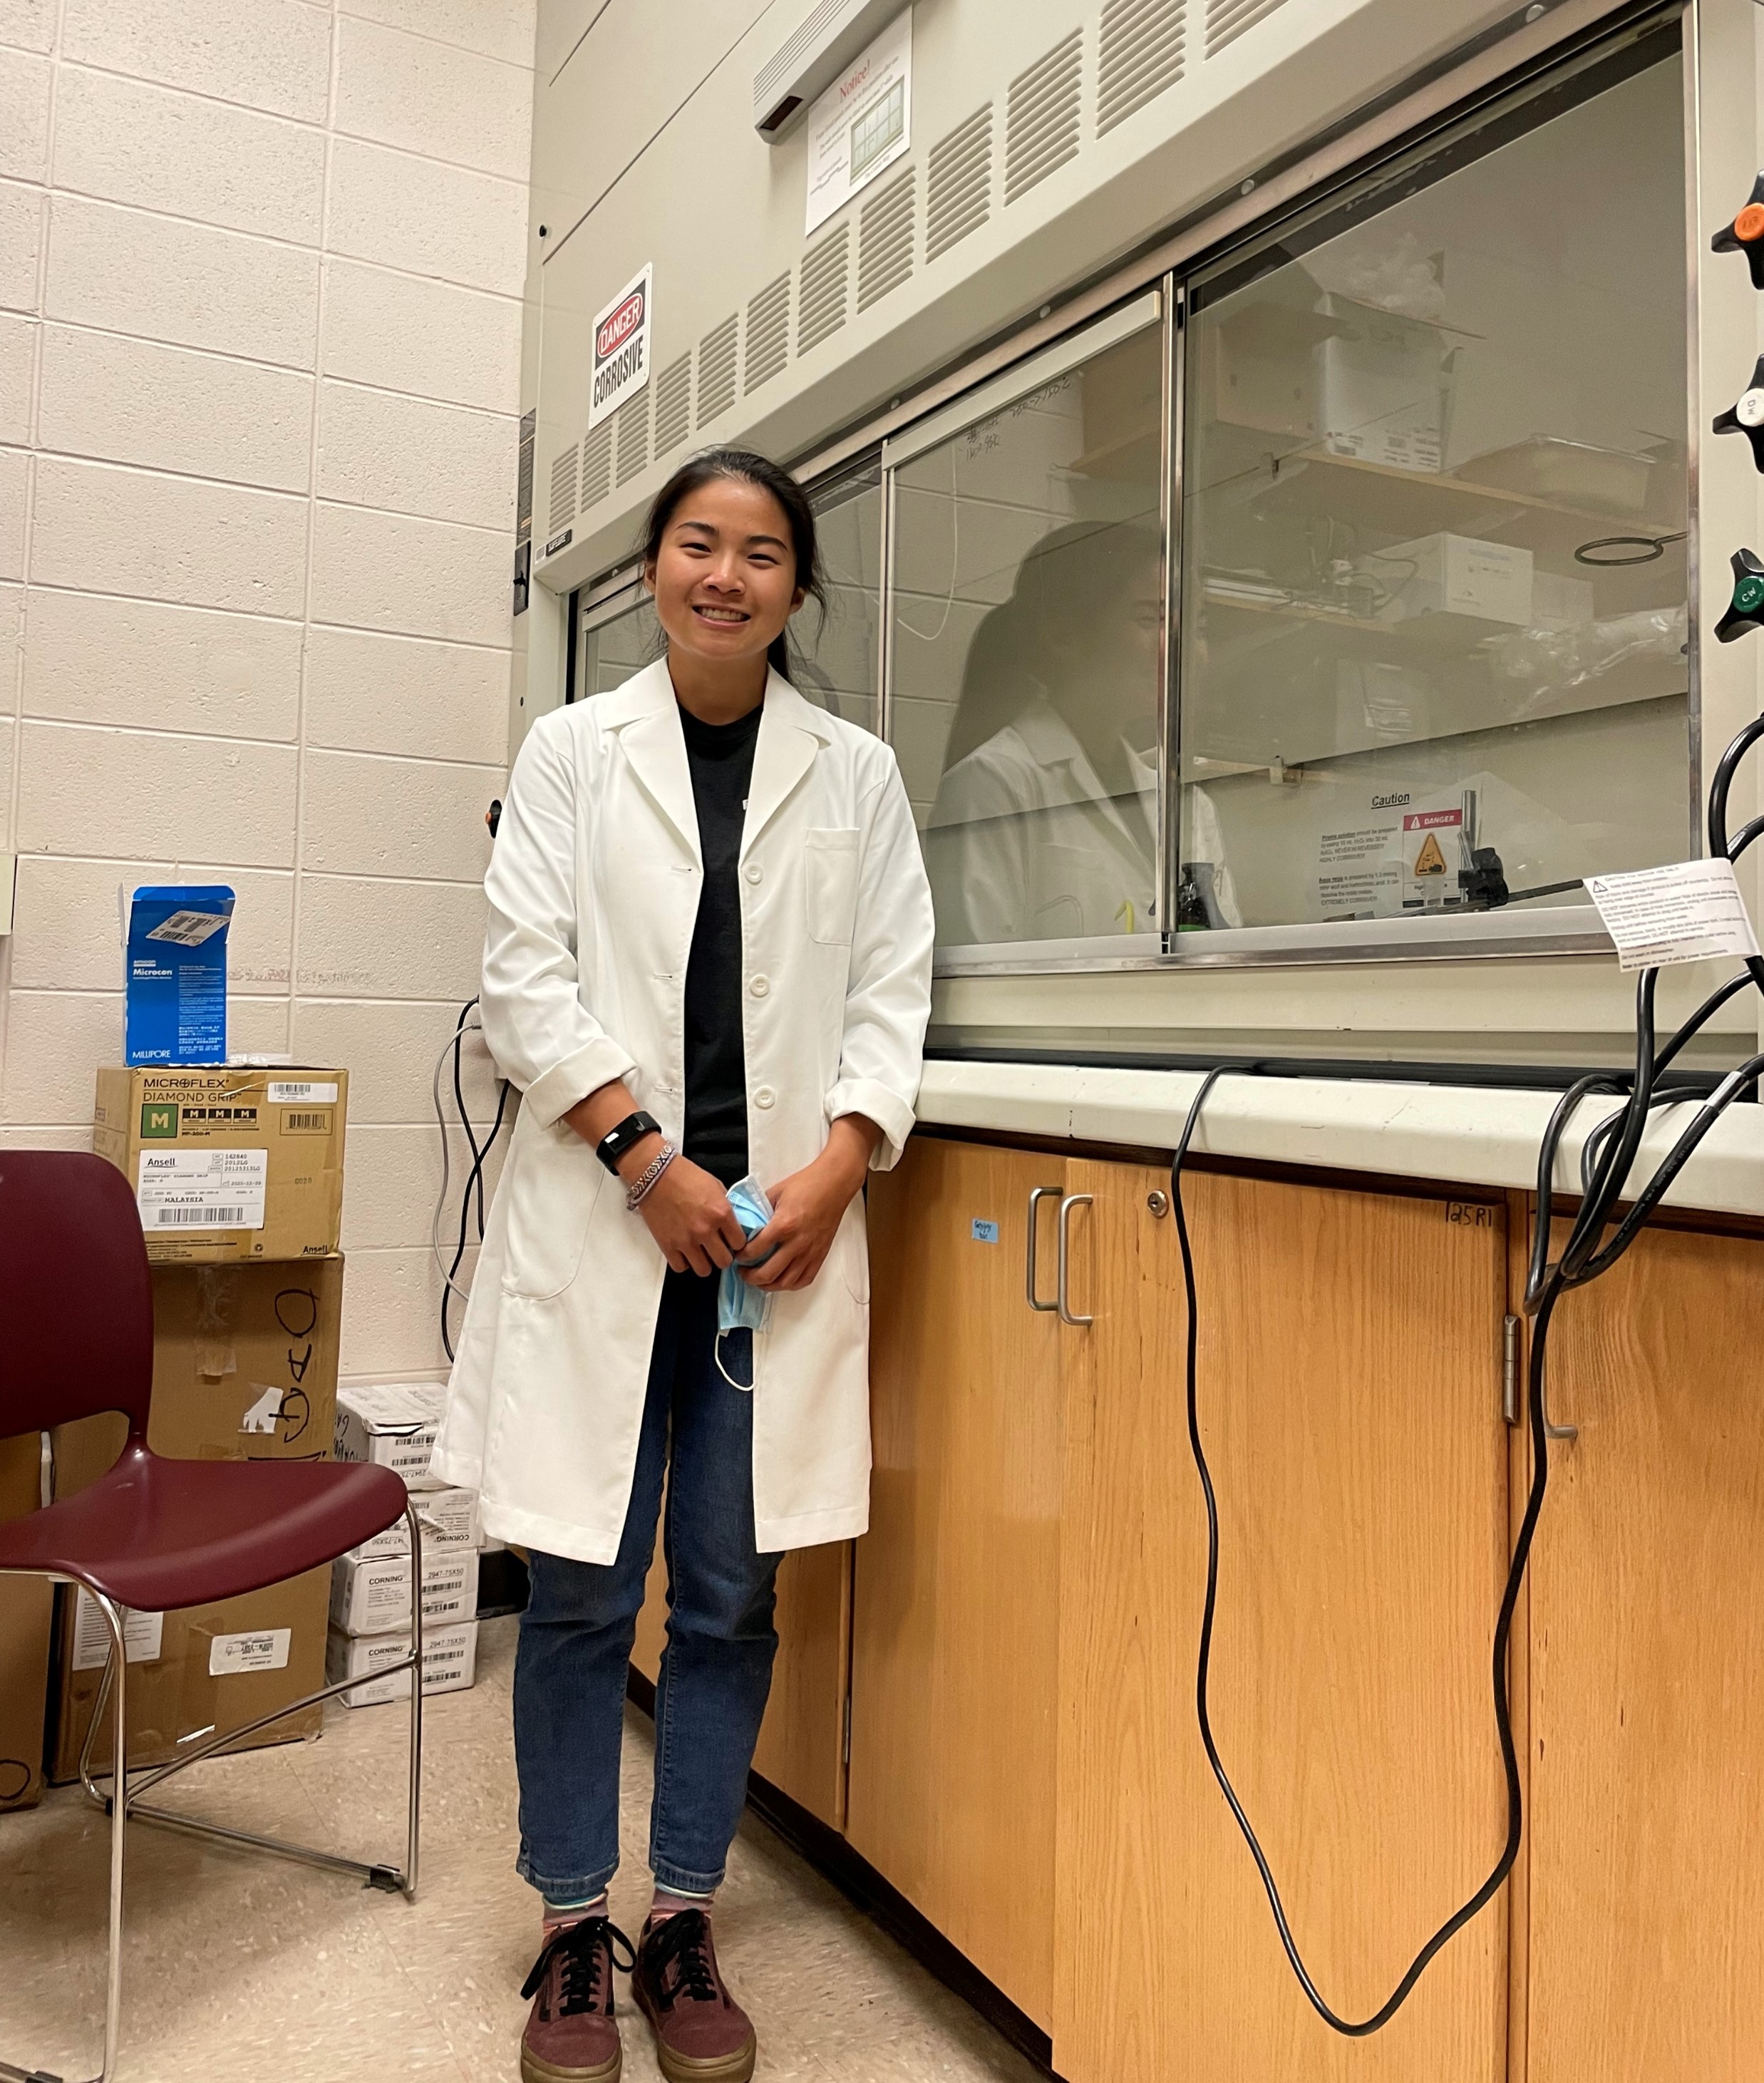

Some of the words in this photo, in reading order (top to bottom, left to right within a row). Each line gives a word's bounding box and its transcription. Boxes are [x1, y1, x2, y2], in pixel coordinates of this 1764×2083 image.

[840, 59, 870, 103] Notice!
[600, 297, 640, 354] DANGER
[594, 334, 644, 408] CORROSIVE
[1742, 587, 1756, 602] CW
[1371, 793, 1410, 808] Caution
[1424, 816, 1455, 825] DANGER
[133, 1049, 171, 1059] MILLIPORE
[144, 1079, 225, 1089] MICROFLEX
[144, 1092, 204, 1102] DIAMOND
[208, 1092, 237, 1102] GRIP
[151, 1113, 169, 1128] M
[148, 1158, 175, 1166] Ansell
[303, 1245, 328, 1253] Ansell
[436, 1534, 470, 1543] CORNING
[428, 1568, 464, 1578] 2947-75X50
[368, 1575, 403, 1585] CORNING
[368, 1646, 403, 1656] CORNING
